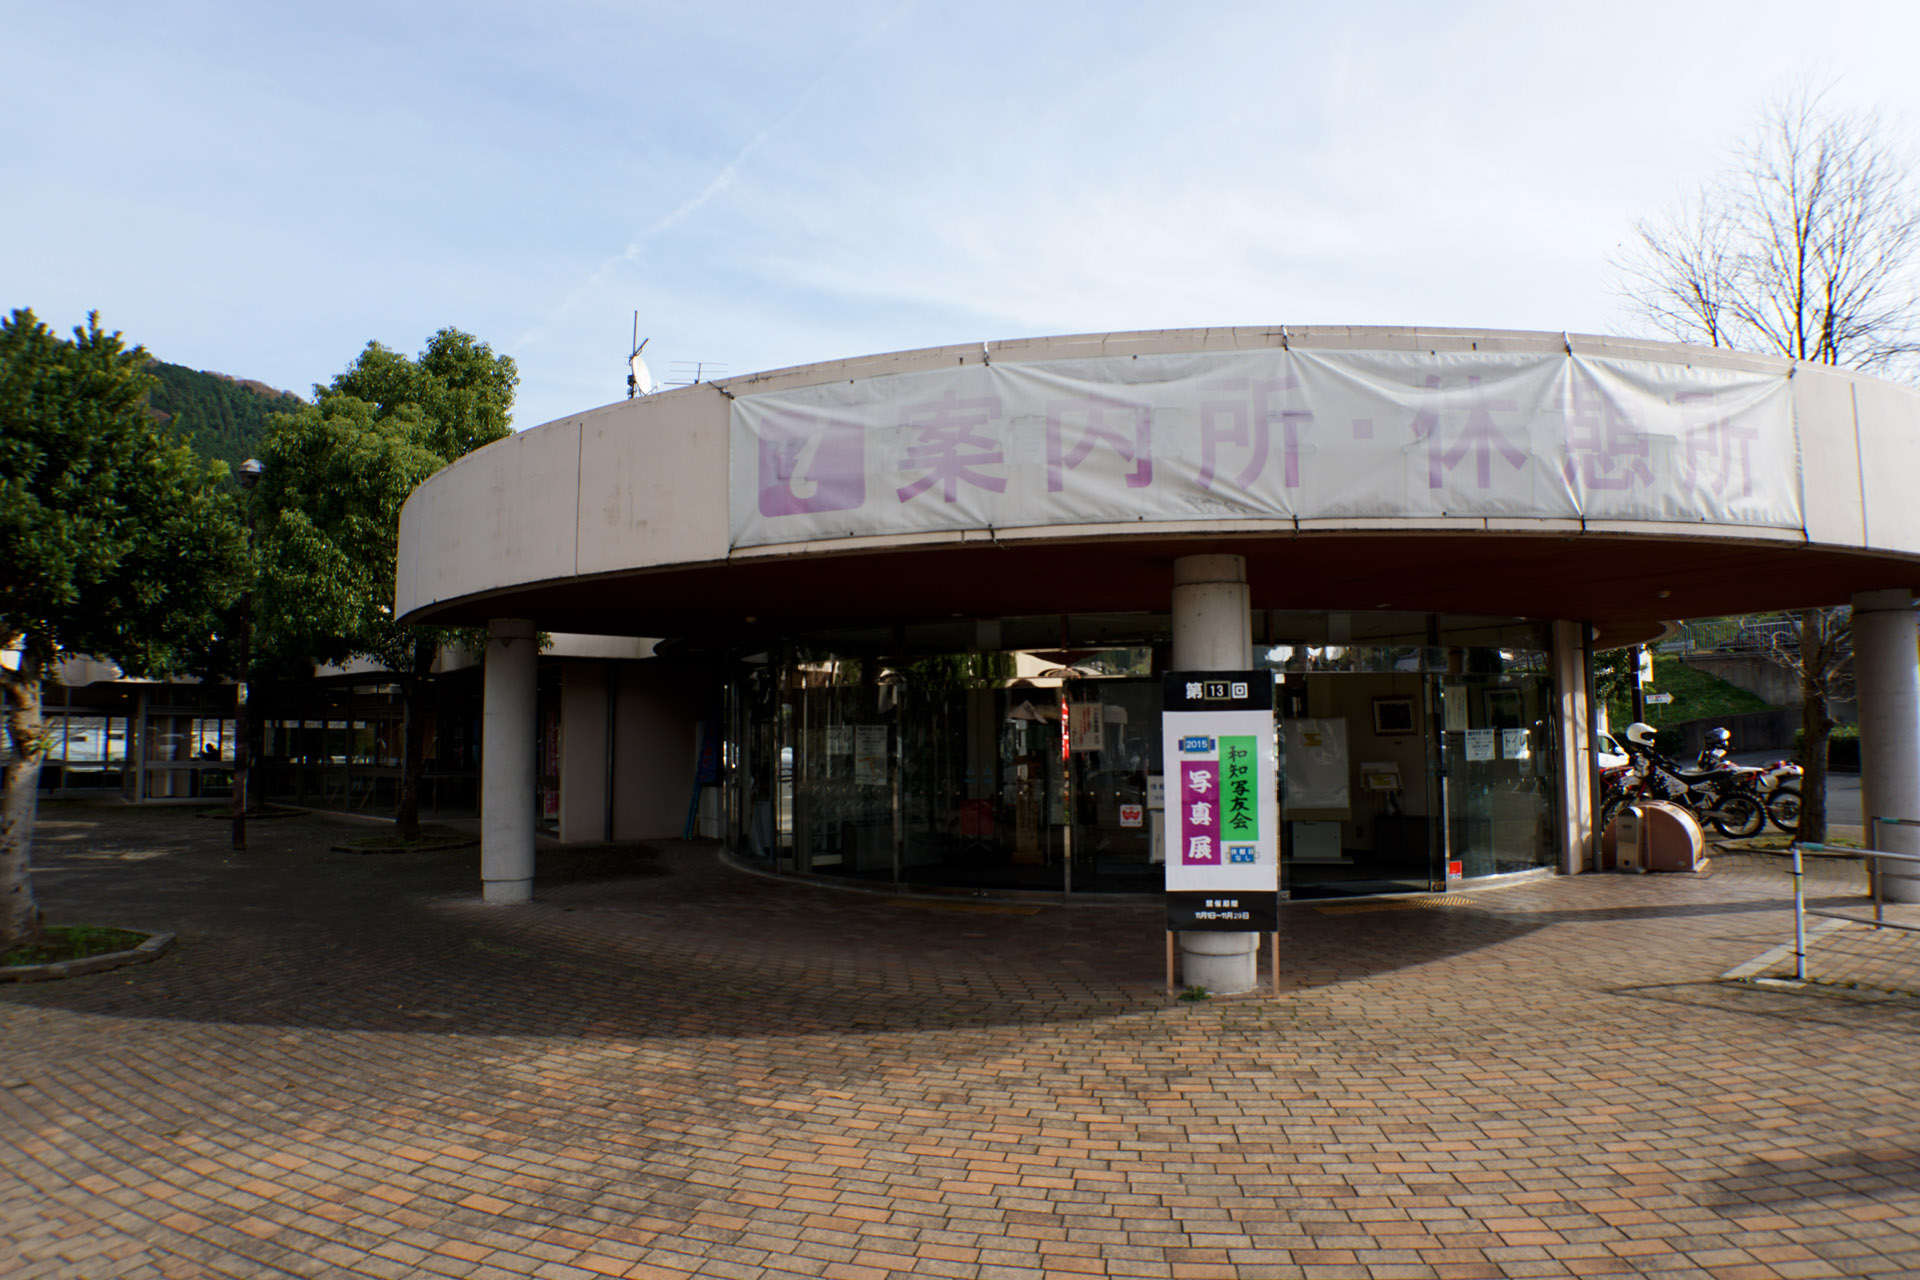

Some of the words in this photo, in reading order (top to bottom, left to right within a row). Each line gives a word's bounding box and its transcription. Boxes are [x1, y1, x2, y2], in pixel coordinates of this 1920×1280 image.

[1185, 681, 1249, 699] 第13回
[1185, 739, 1208, 749] 2015
[1227, 745, 1253, 831] 和知写友会
[1188, 770, 1212, 859] 写真展
